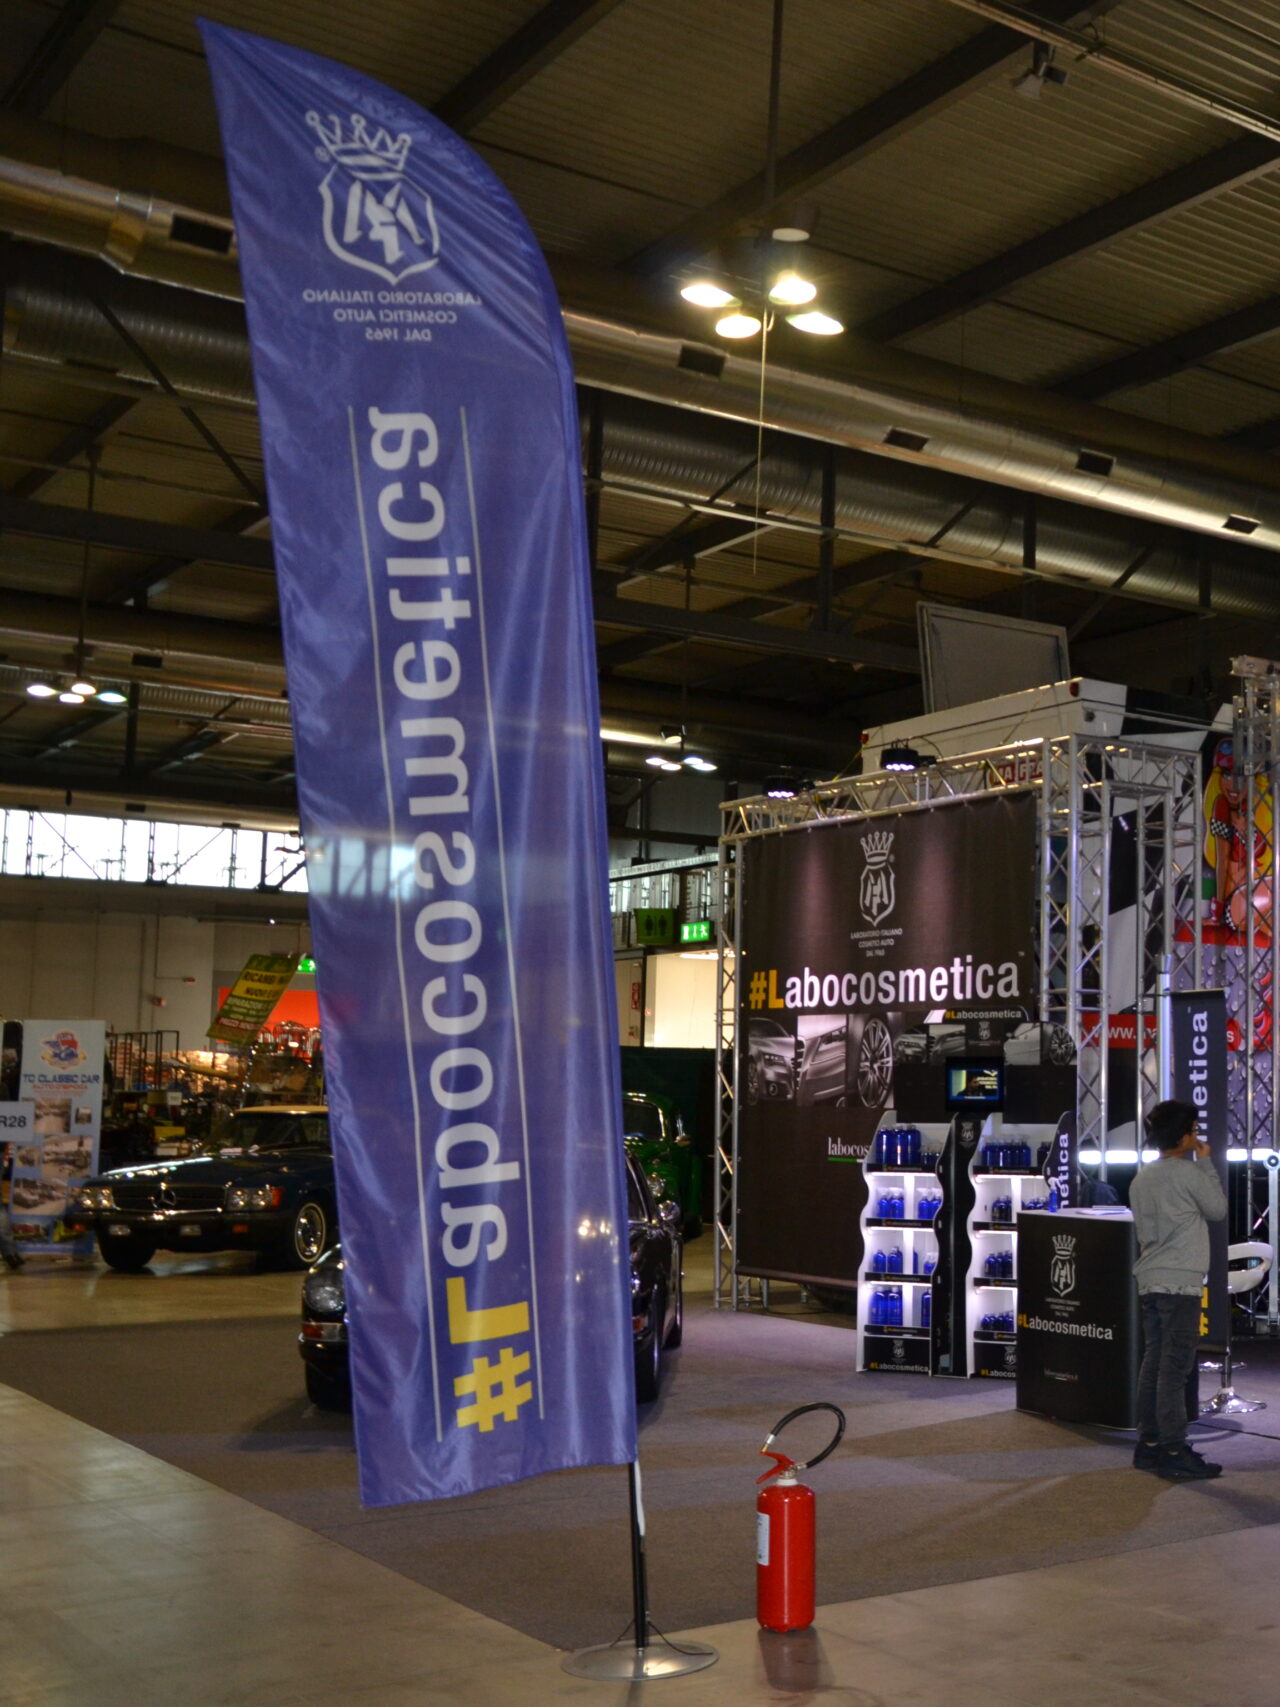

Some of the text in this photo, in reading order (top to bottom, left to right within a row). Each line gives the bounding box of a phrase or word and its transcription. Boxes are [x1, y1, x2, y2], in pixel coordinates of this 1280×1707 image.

[749, 955, 1020, 1009] #Labocosmetica
[945, 1010, 1022, 1019] #Labocosmetica
[1018, 1313, 1113, 1341] #Labocosmetica
